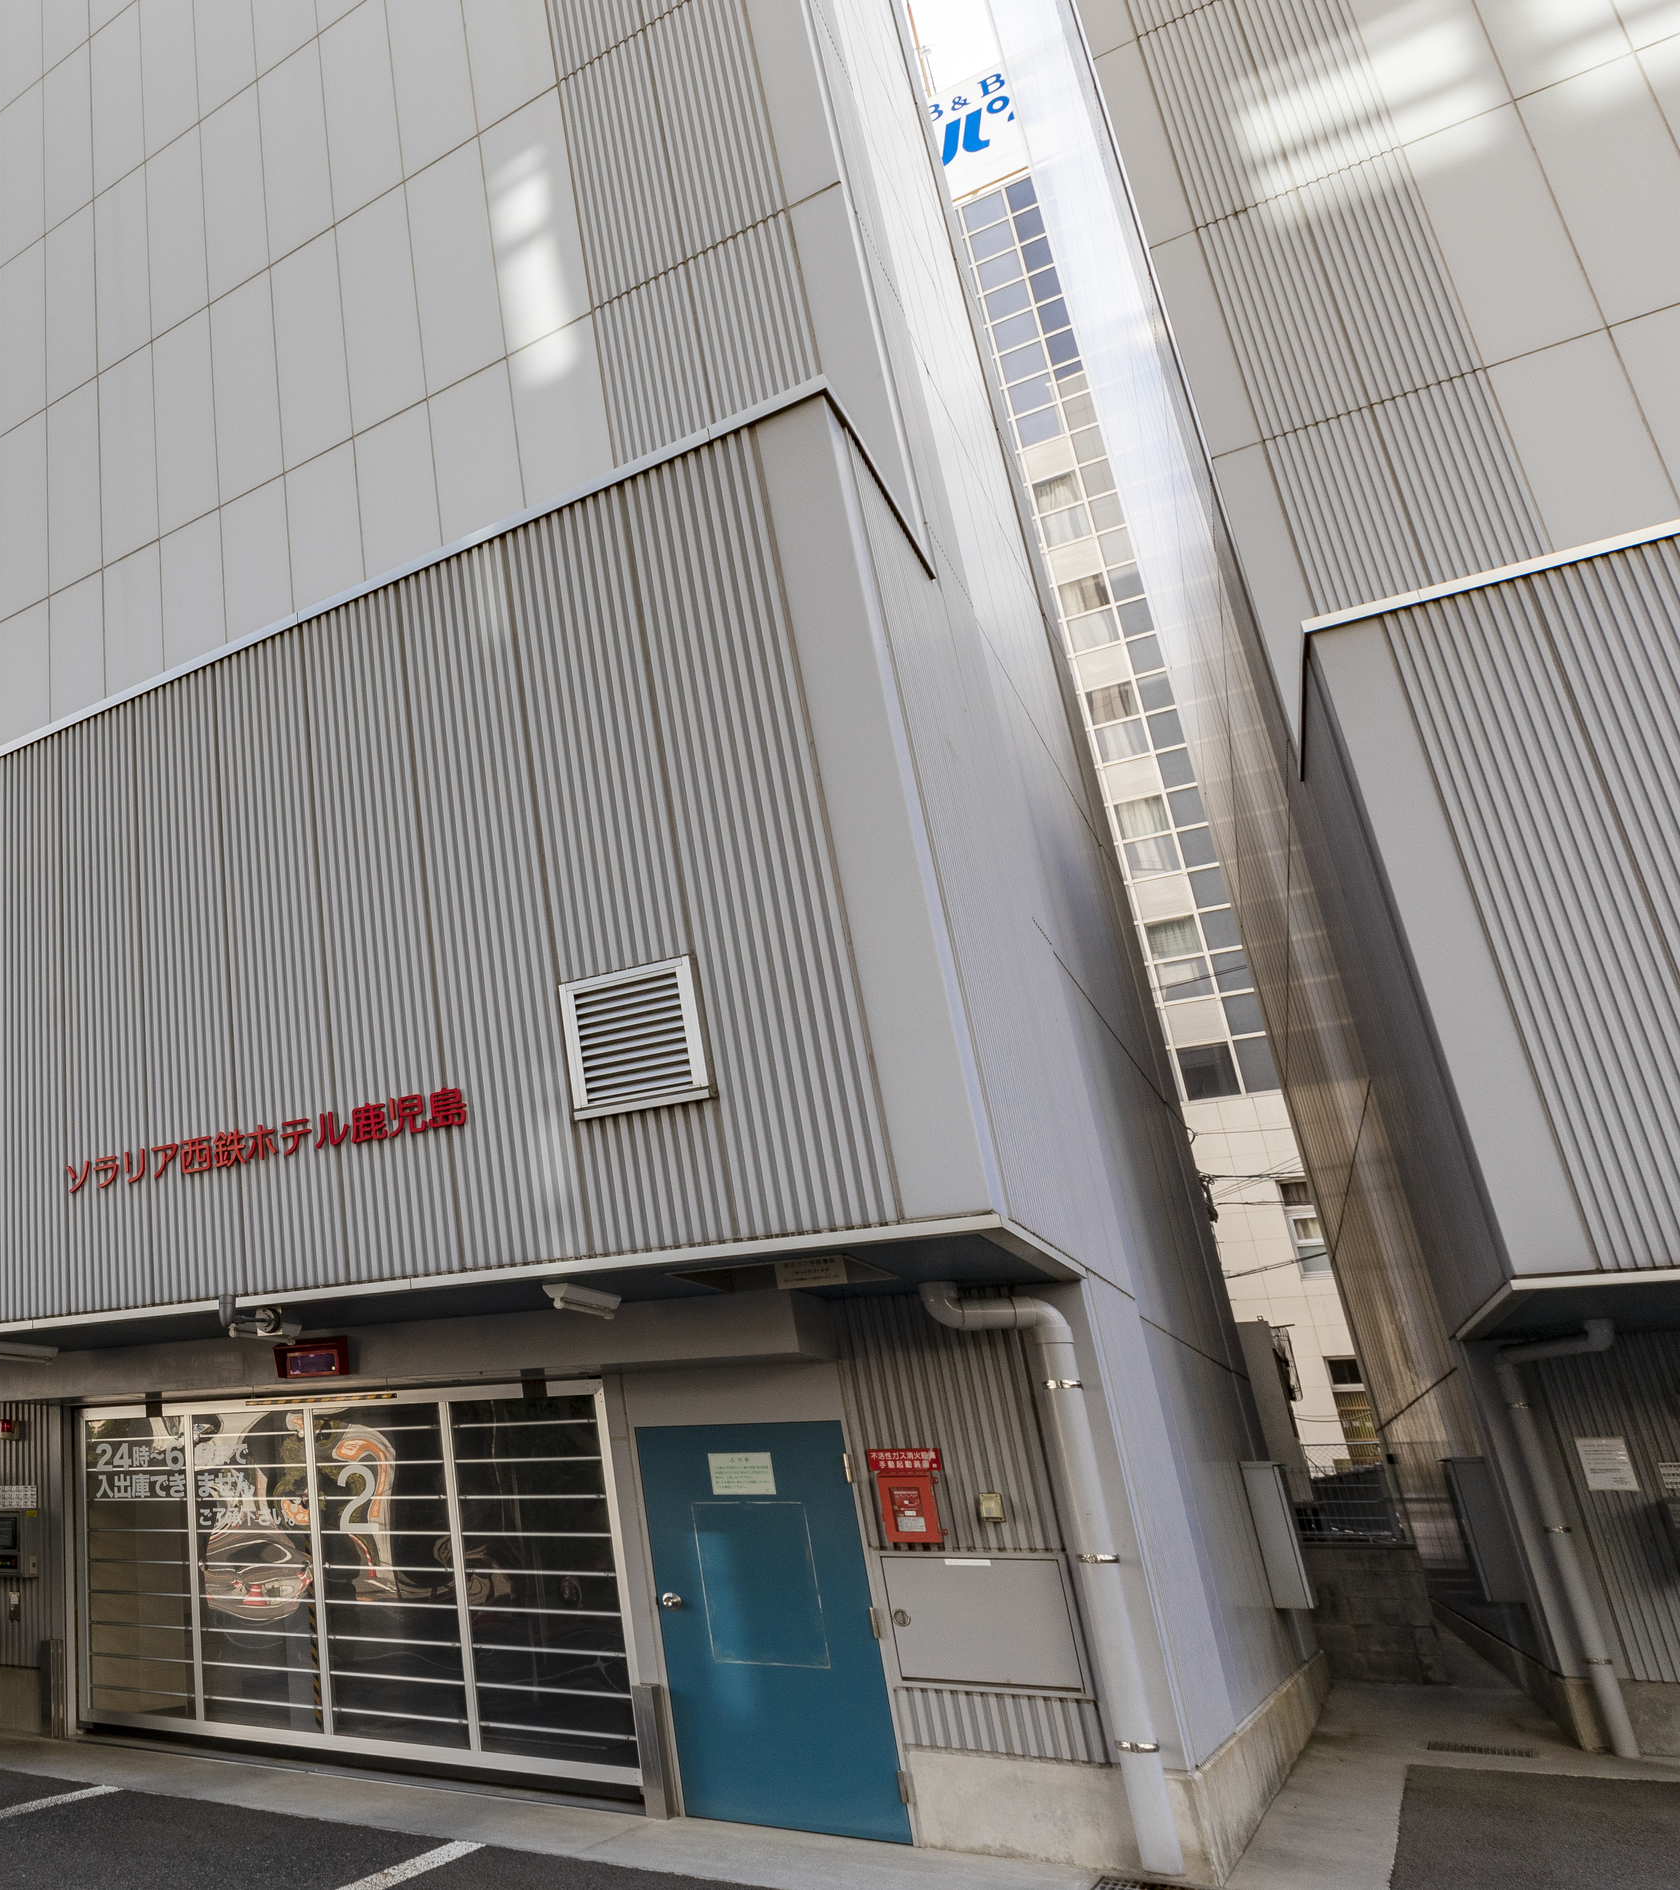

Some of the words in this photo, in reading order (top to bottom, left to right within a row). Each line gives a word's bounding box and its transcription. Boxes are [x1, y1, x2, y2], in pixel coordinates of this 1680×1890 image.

[951, 95, 971, 112] &
[977, 73, 1006, 98] B
[66, 1086, 468, 1194] ソラリア西鉄ホテル鹿児島
[337, 1464, 380, 1532] 2
